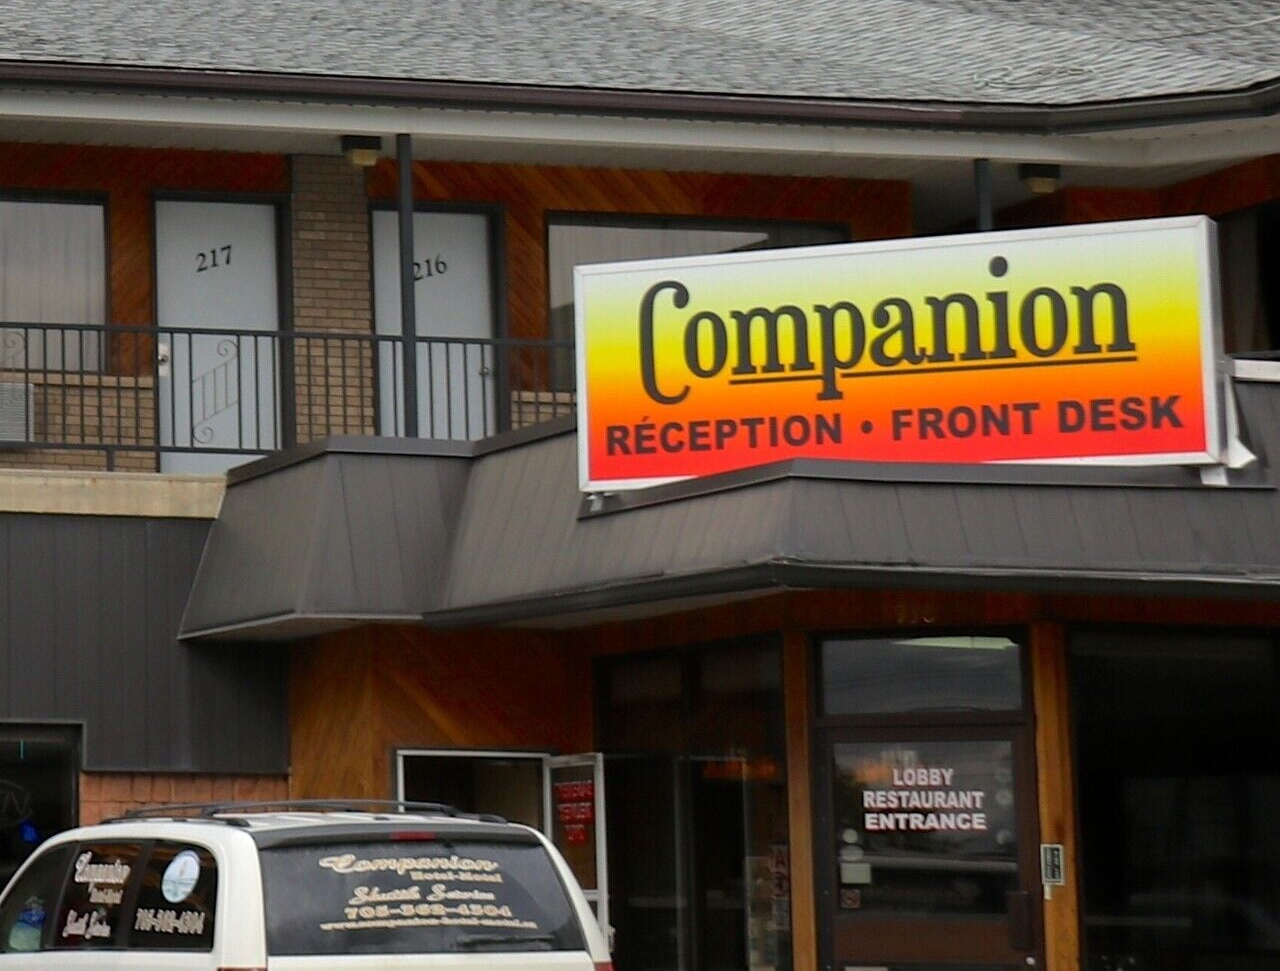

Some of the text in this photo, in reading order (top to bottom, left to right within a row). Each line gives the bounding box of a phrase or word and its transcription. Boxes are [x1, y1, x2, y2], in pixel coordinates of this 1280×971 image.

[195, 244, 233, 273] 217
[639, 255, 1137, 406] Companion
[605, 395, 1185, 457] RÉCEPTION FRONT DESK
[892, 768, 954, 786] LOBBY
[862, 790, 985, 809] RESTAURANT
[864, 813, 988, 830] ENTRANCE
[318, 854, 499, 875] Companion
[426, 883, 496, 902] Service
[344, 903, 513, 920] 705-362-4304
